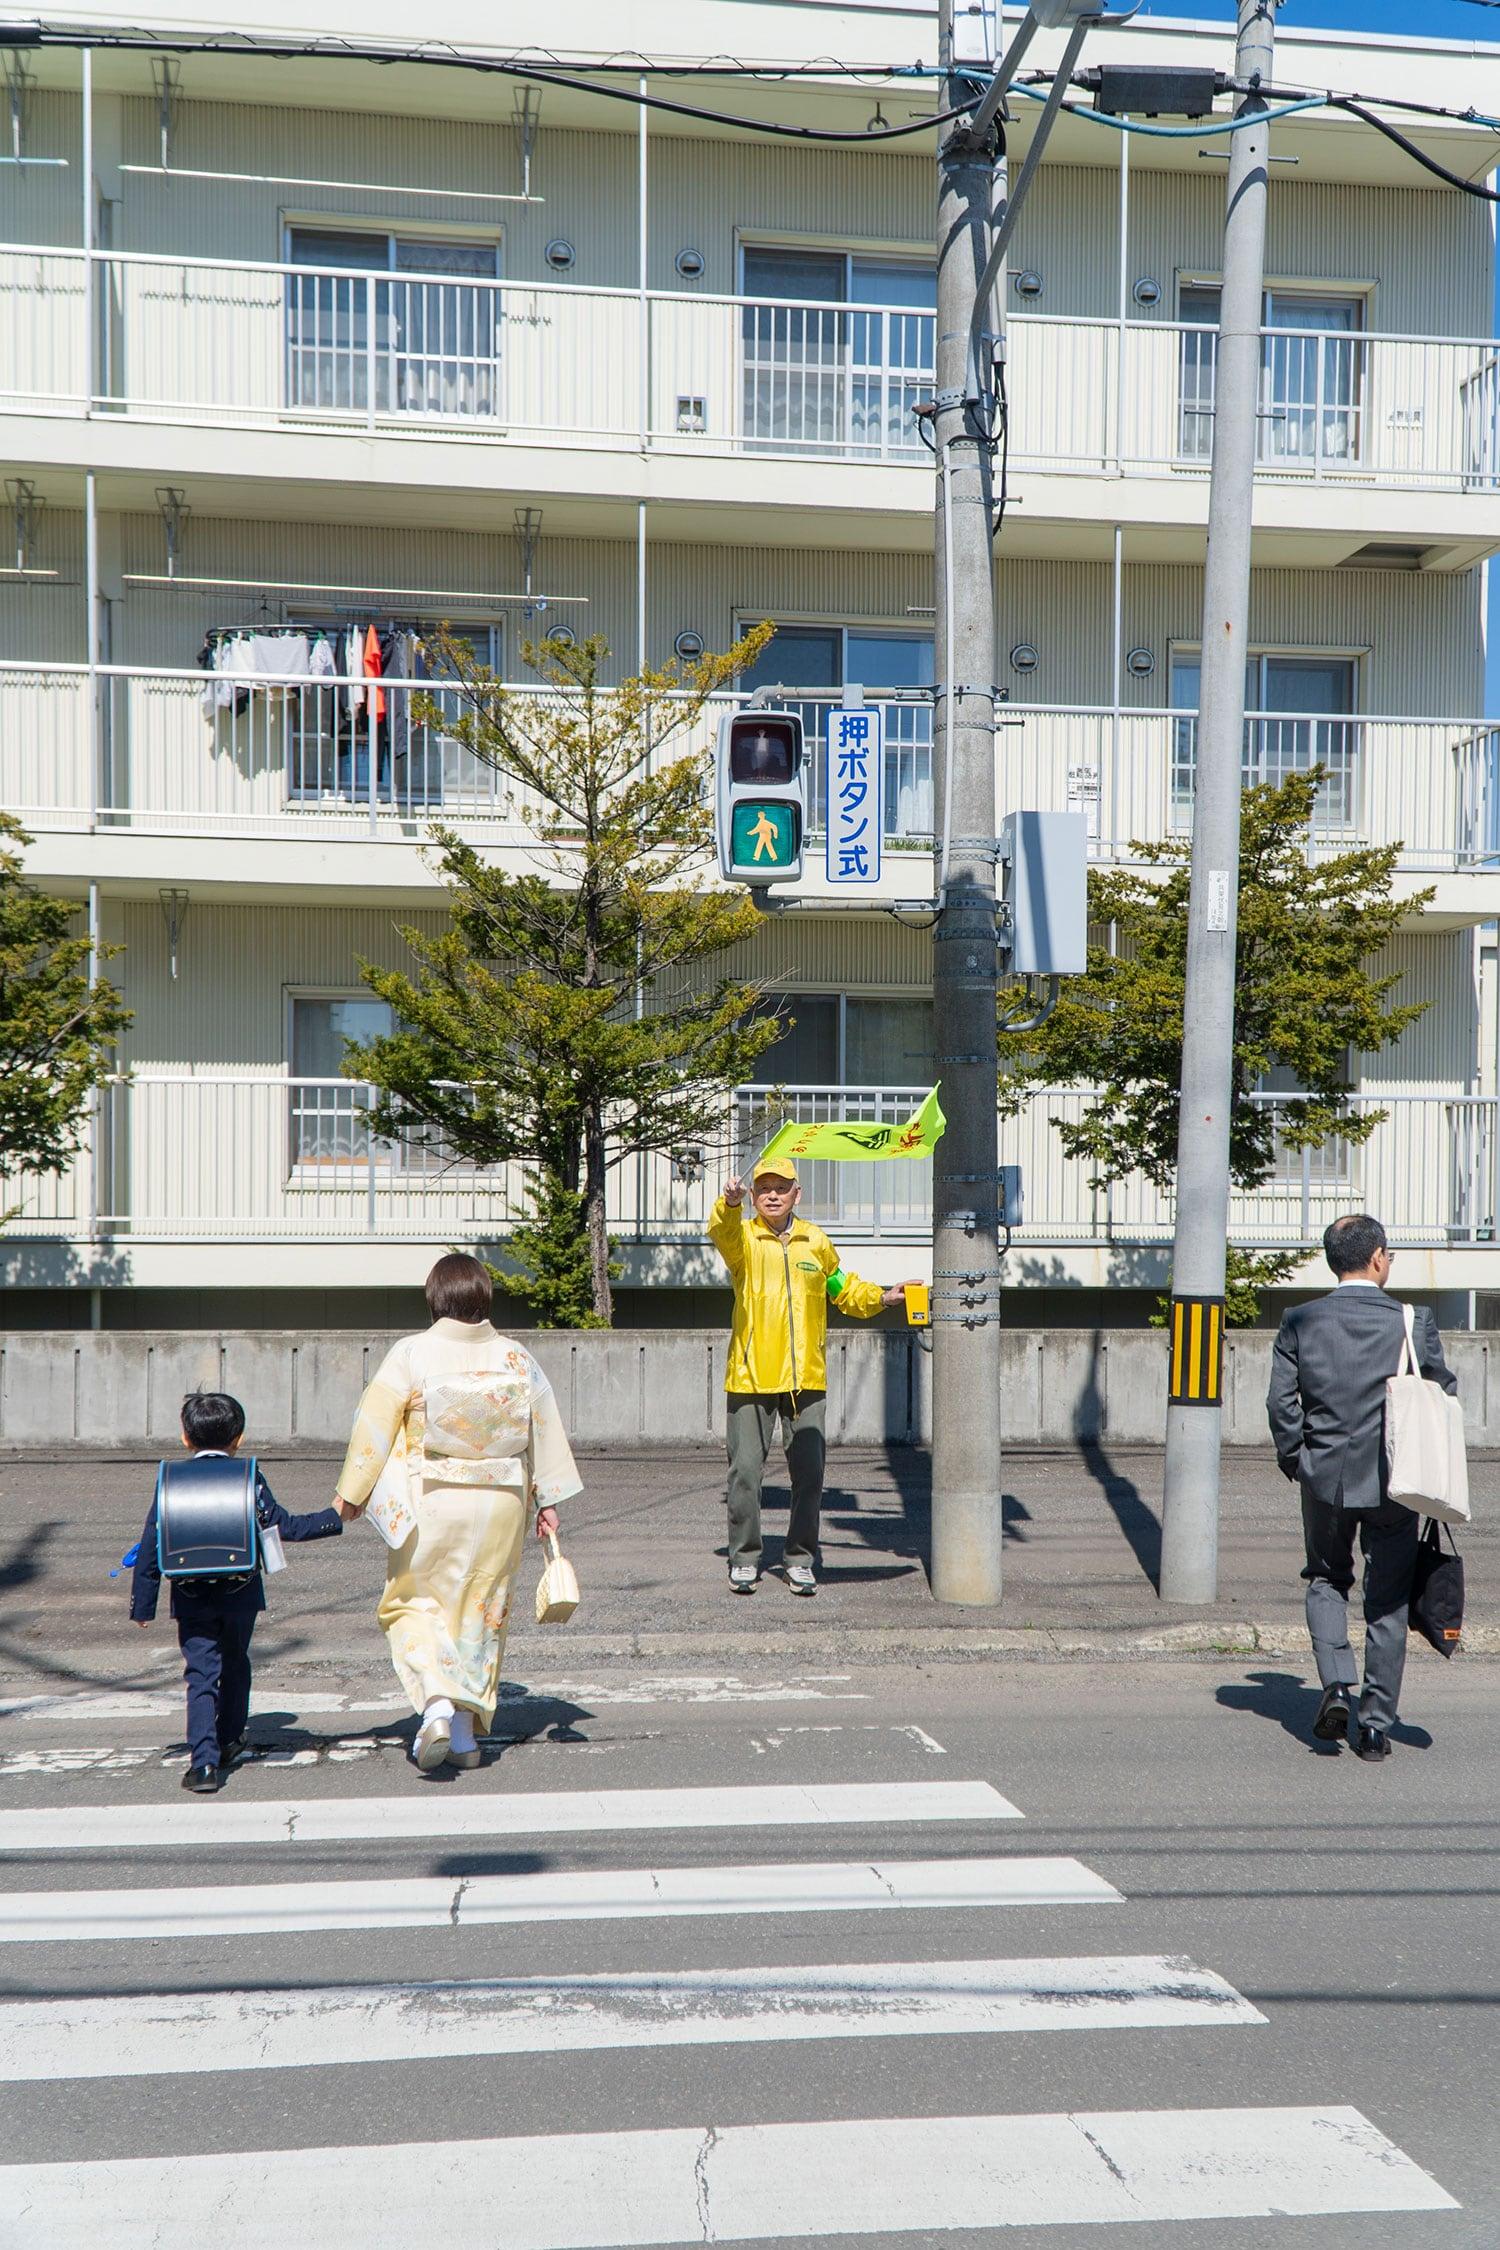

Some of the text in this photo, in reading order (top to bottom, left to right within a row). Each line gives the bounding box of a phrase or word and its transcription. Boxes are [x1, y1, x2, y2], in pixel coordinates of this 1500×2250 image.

[838, 715, 869, 877] 押ボタン式
